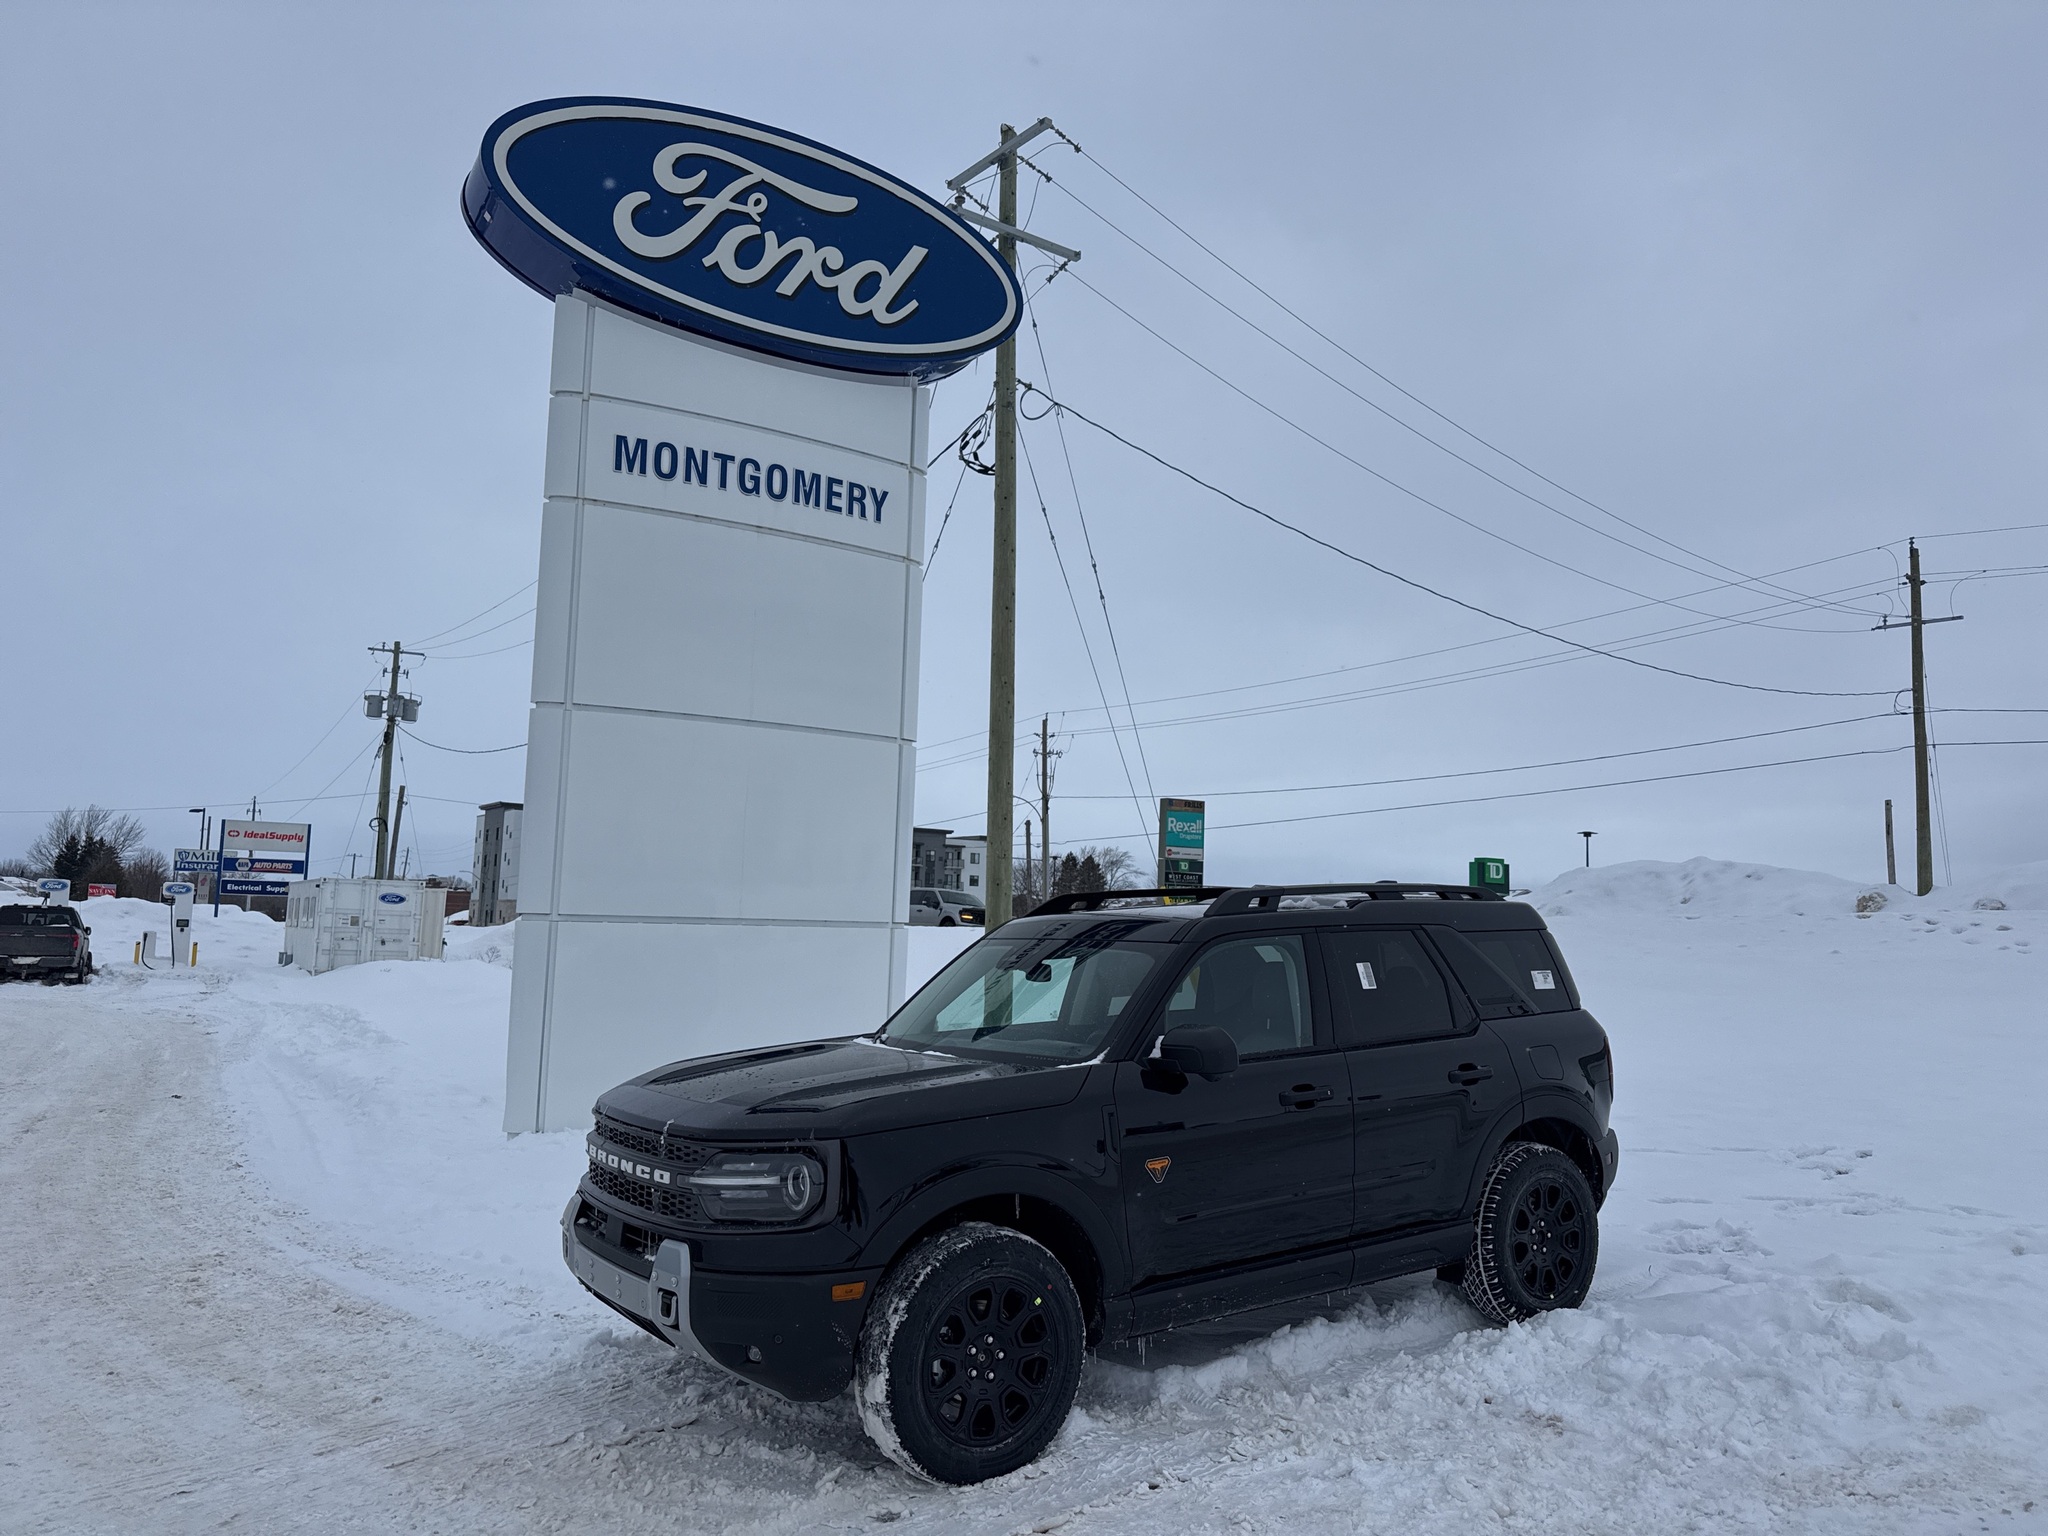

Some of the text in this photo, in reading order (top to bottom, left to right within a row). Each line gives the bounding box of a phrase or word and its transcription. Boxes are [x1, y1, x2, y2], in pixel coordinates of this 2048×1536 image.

[613, 141, 929, 325] Ford
[613, 433, 890, 523] MONTGOMERY
[1168, 817, 1202, 834] Rexall
[253, 861, 272, 869] AUTO
[272, 862, 293, 870] PARTS
[1180, 862, 1189, 870] TD
[1487, 862, 1503, 879] TD
[226, 883, 262, 891] Electrical
[589, 1143, 671, 1184] BRONCO
